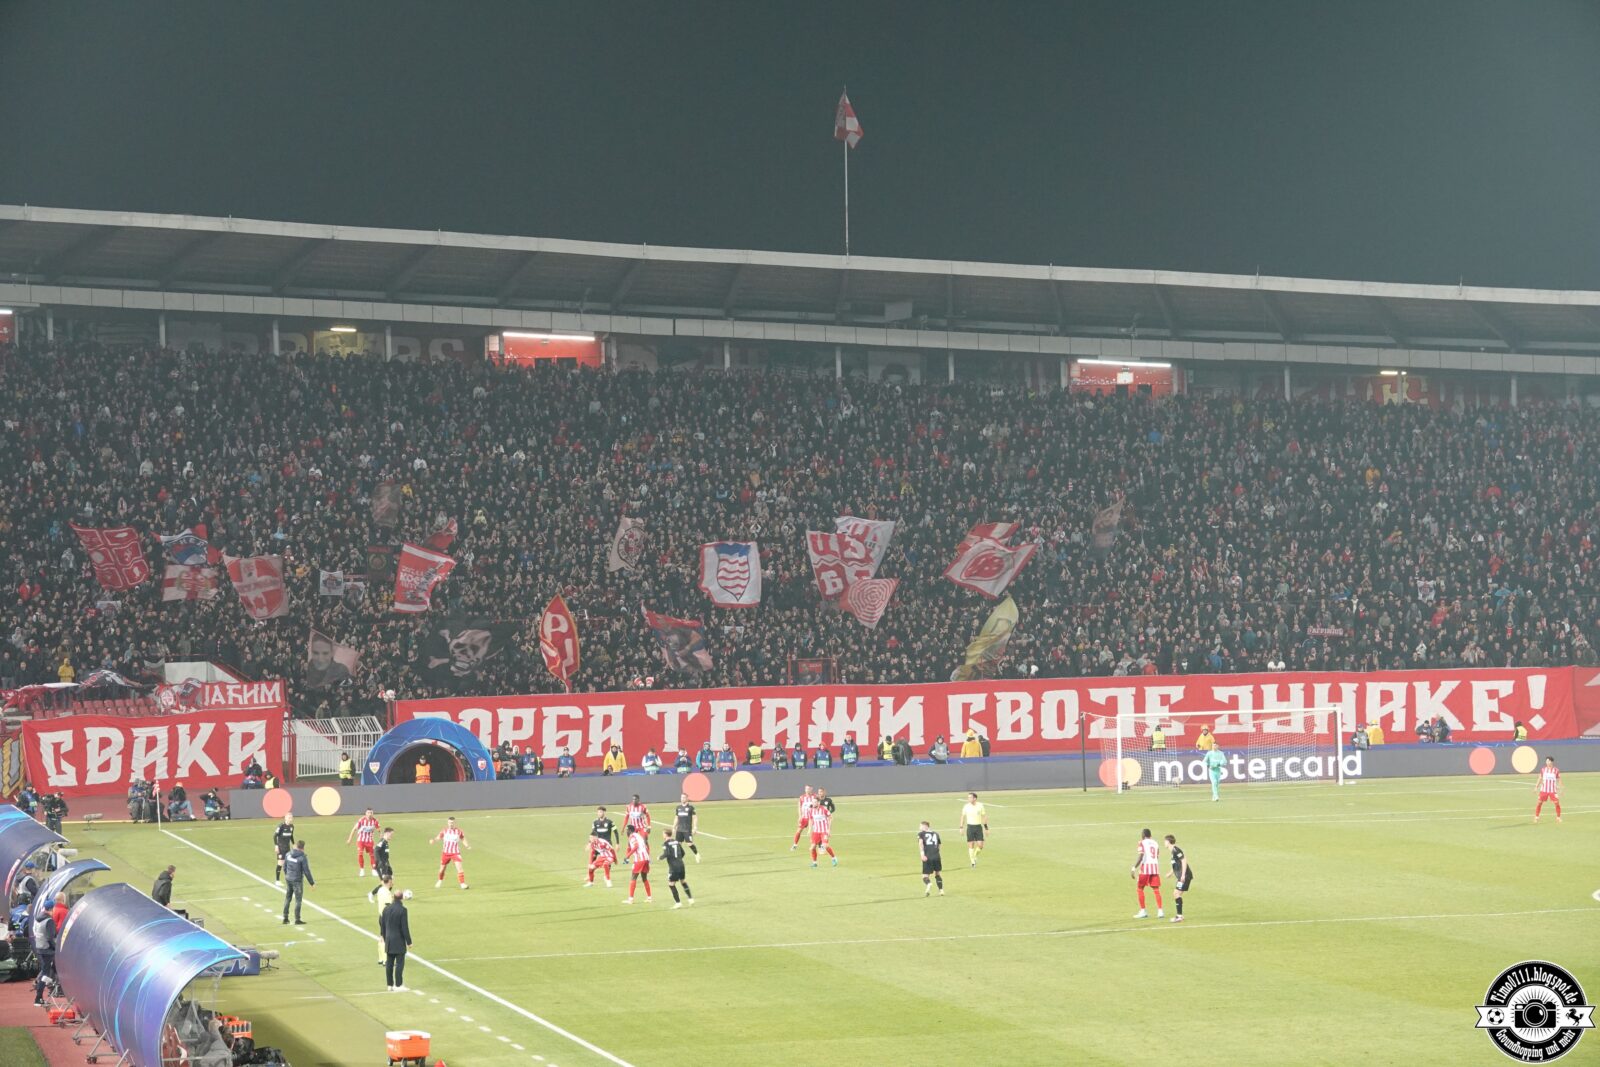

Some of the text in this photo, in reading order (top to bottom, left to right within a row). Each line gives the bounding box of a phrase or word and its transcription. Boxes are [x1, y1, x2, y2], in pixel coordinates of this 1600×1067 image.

[413, 704, 625, 759] ОРБА
[645, 695, 926, 753] ТРАЖИ
[947, 684, 1186, 744] СВОЈЕ
[1211, 674, 1547, 735] ЈУНАКЕ!
[37, 720, 267, 787] СВАКА
[1153, 749, 1363, 782] mastercard
